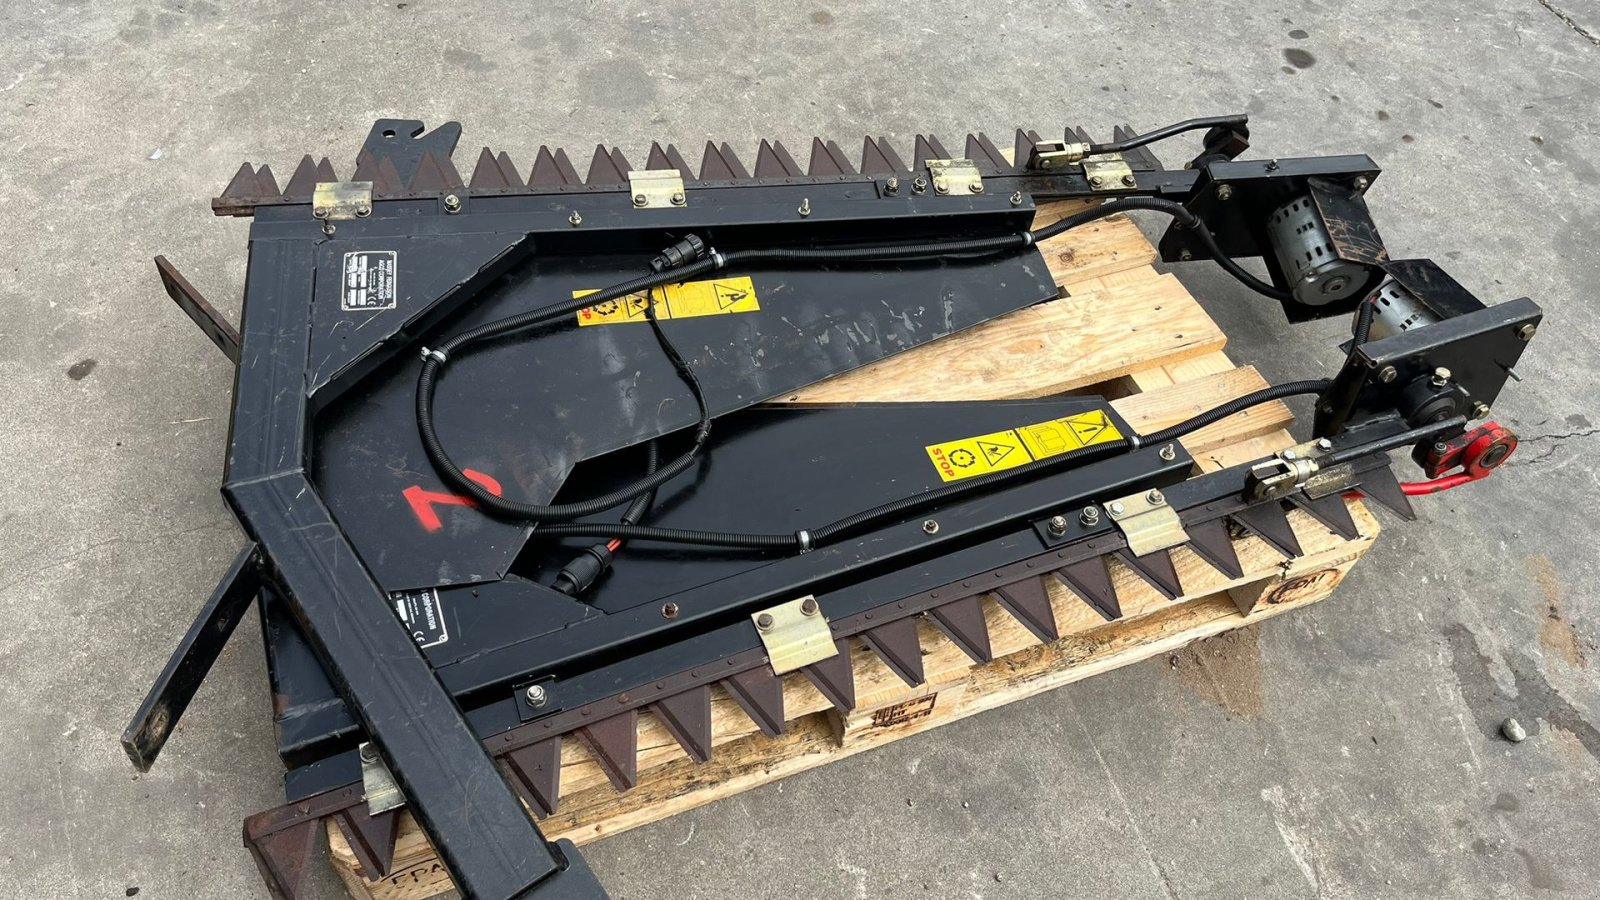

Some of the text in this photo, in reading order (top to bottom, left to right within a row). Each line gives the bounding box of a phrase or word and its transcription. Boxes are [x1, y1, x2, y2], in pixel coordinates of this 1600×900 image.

[385, 276, 393, 299] FERGUSON
[932, 447, 955, 478] STOP
[421, 592, 437, 631] CORPORATION
